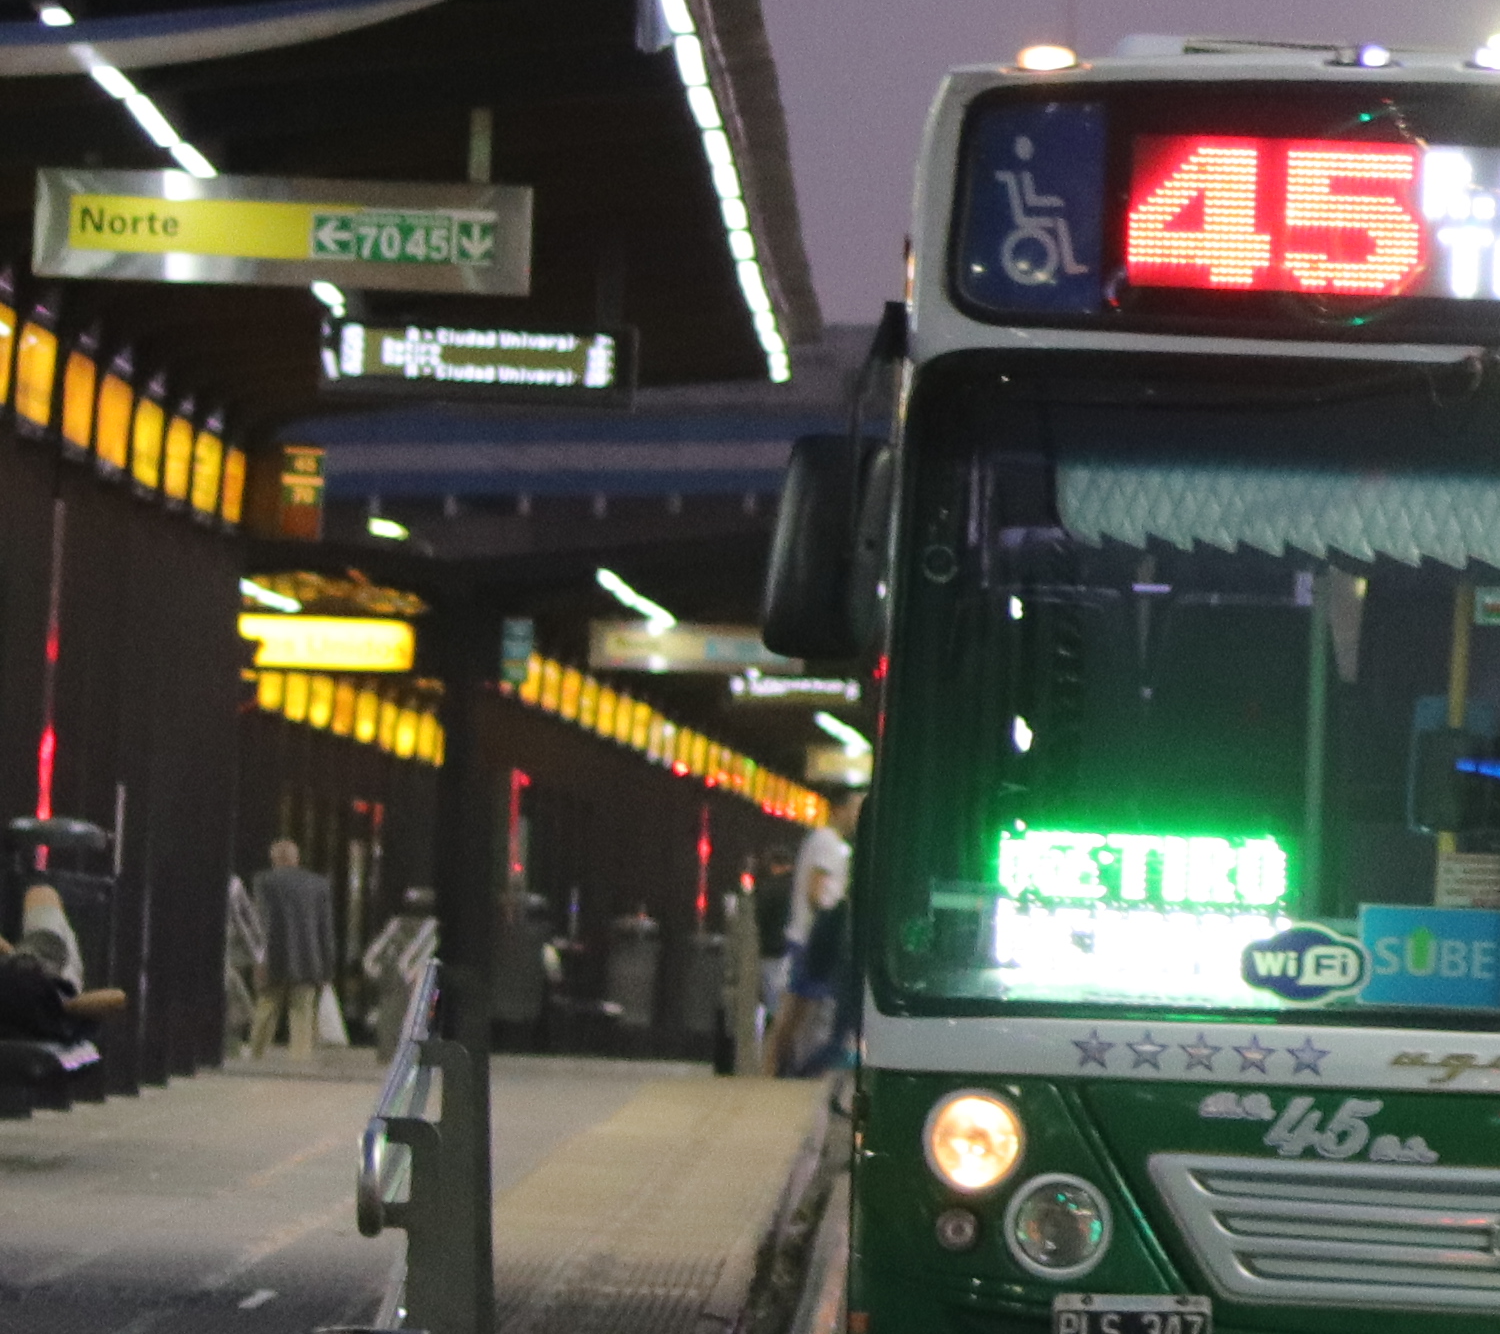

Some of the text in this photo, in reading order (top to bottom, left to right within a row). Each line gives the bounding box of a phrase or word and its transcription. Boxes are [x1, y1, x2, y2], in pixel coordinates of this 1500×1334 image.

[79, 206, 449, 261] Norte 70 45
[1127, 145, 1420, 289] 45
[1374, 928, 1498, 980] SUBE
[1263, 1096, 1384, 1159] 45
